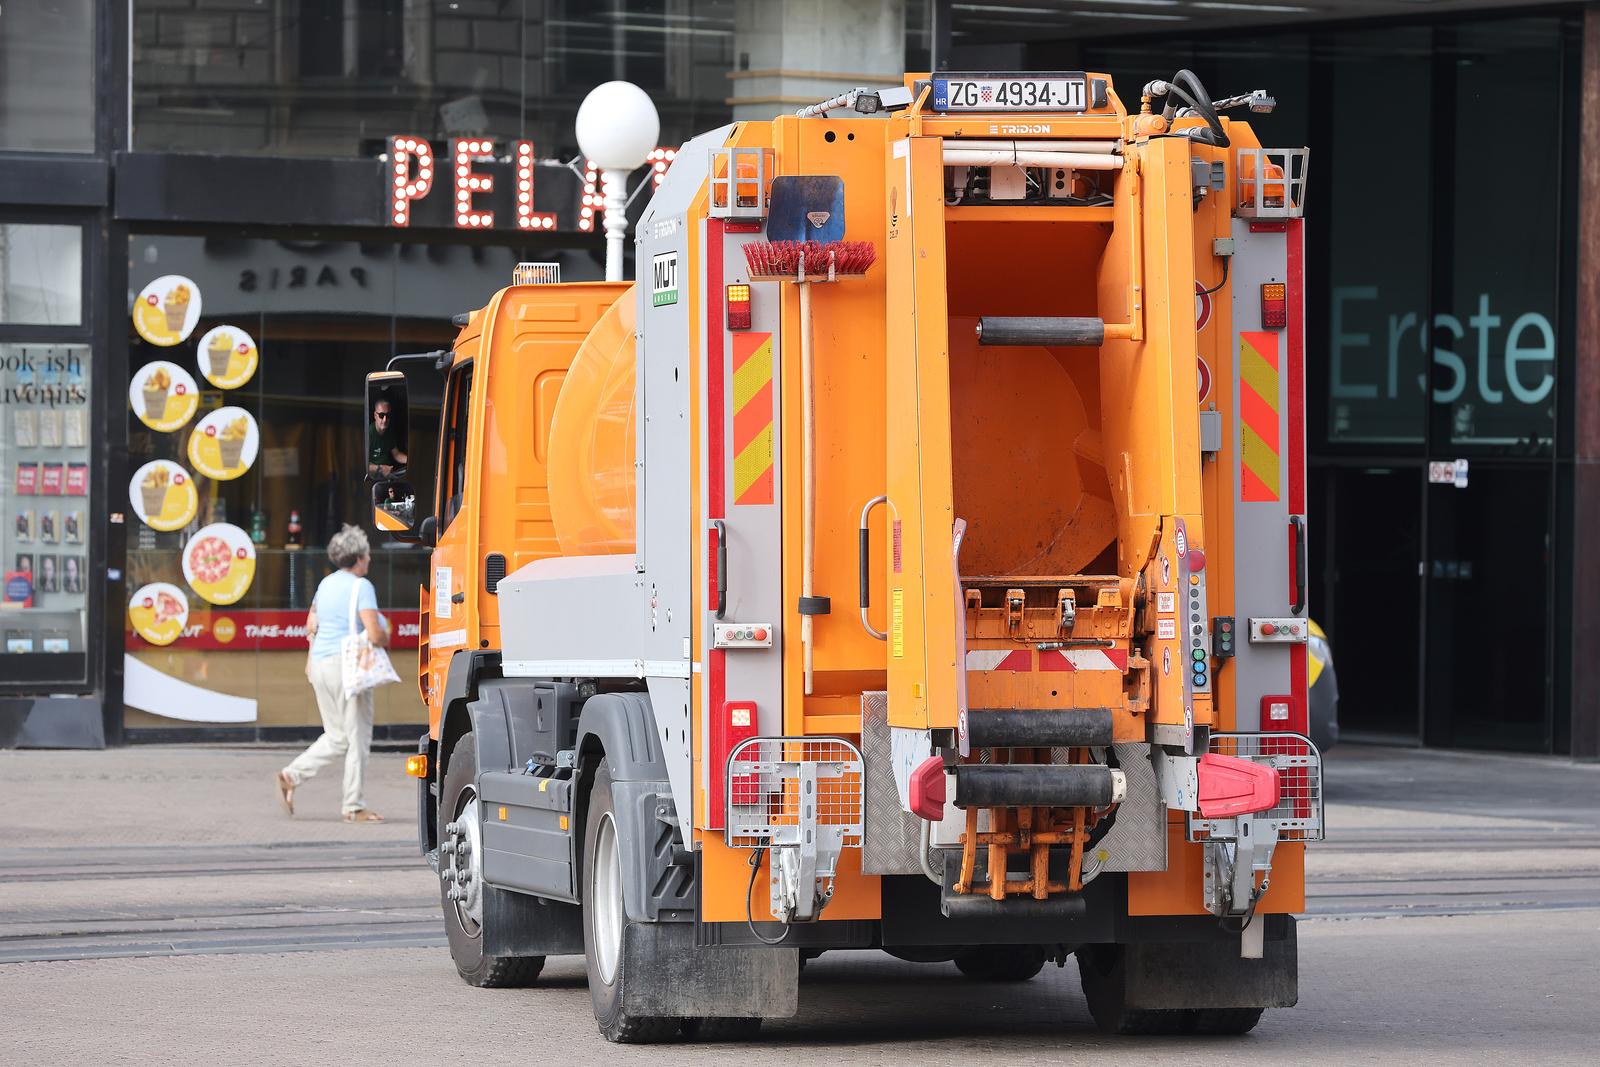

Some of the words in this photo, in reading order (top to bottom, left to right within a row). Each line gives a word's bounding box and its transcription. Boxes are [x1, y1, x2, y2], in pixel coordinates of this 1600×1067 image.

[935, 97, 948, 106] HR
[950, 82, 978, 106] ZG
[654, 259, 677, 290] MUT
[1331, 286, 1556, 404] Erste
